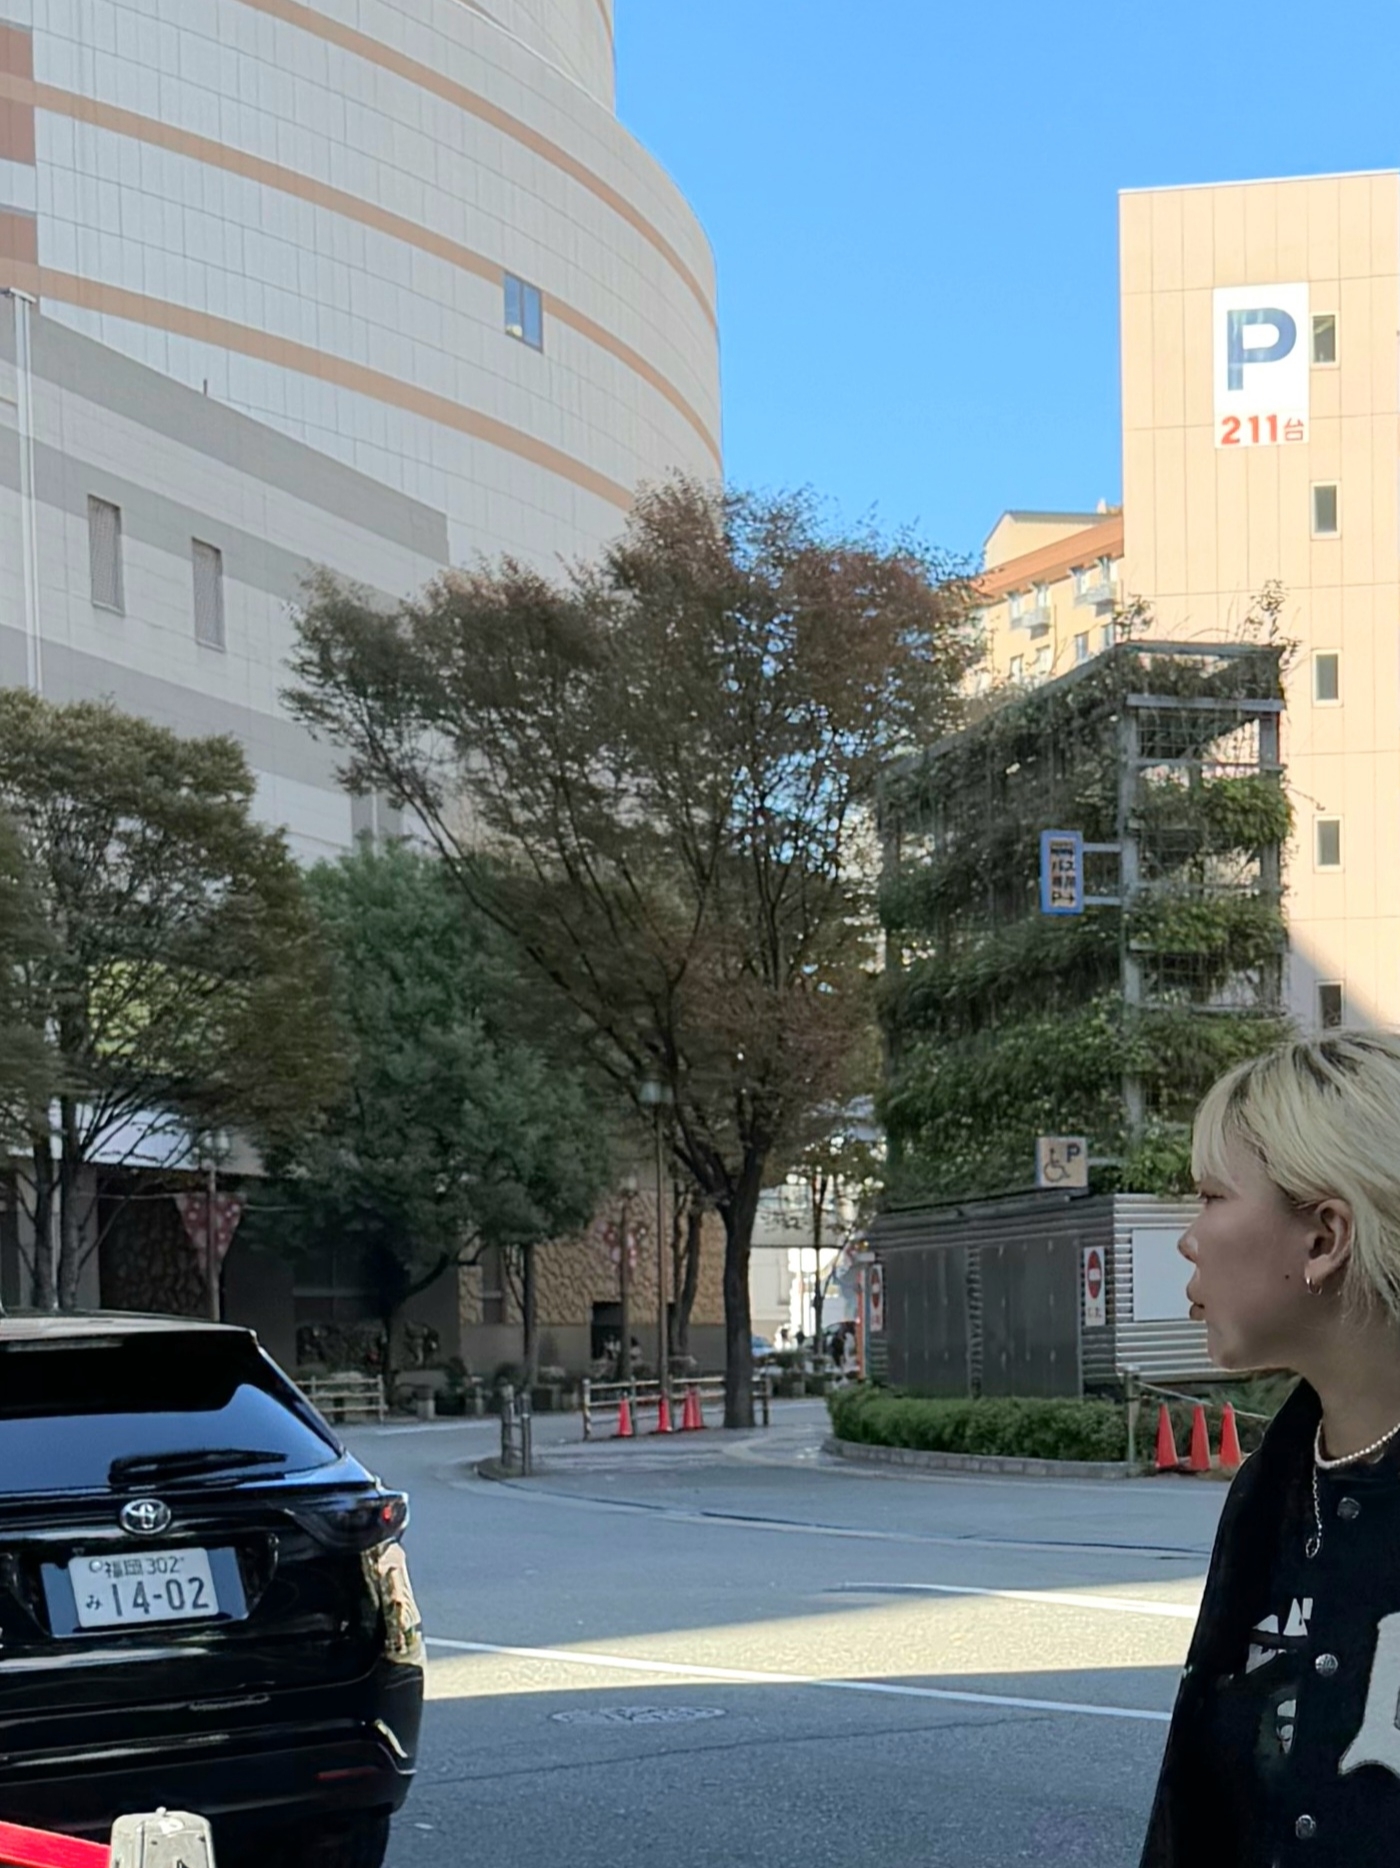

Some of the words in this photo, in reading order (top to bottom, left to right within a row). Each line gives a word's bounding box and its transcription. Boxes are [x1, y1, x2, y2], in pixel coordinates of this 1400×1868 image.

[1227, 307, 1297, 391] P
[1221, 413, 1304, 445] 211台
[1067, 1144, 1080, 1163] P
[104, 1559, 143, 1578] 福岡
[145, 1556, 183, 1575] 302
[111, 1577, 209, 1617] 14-02
